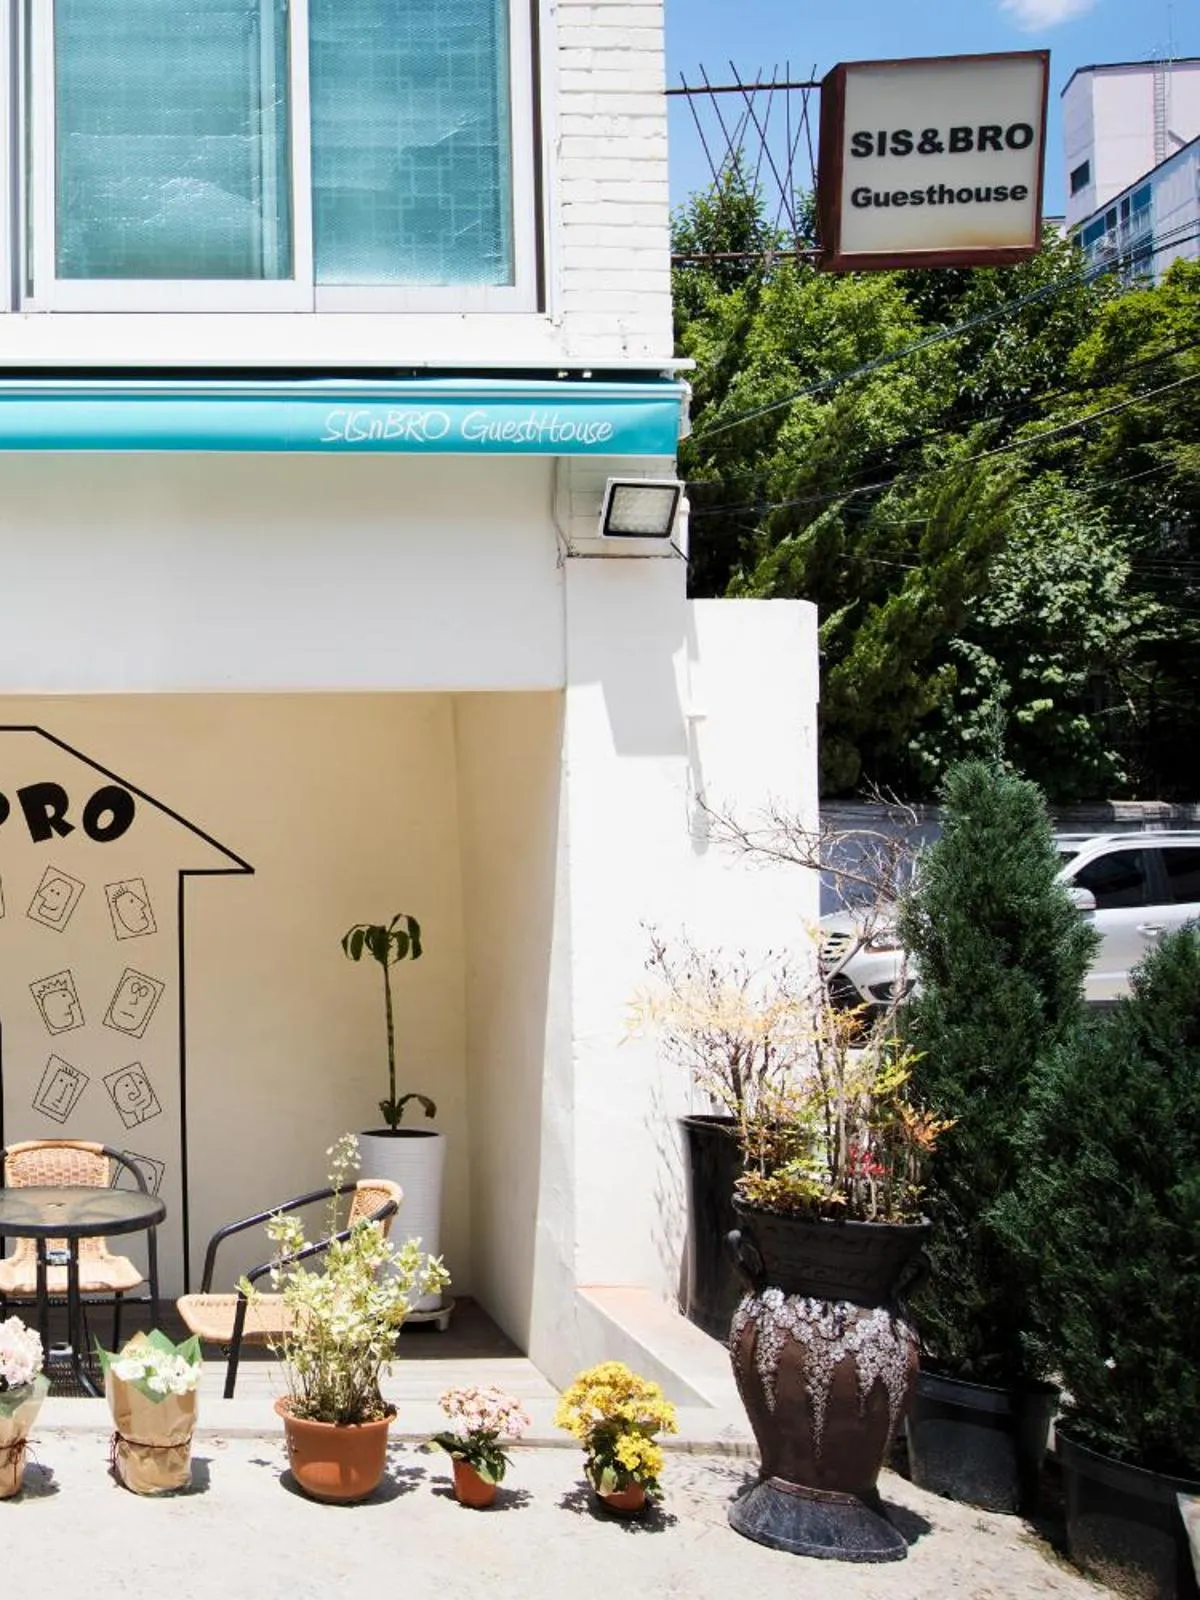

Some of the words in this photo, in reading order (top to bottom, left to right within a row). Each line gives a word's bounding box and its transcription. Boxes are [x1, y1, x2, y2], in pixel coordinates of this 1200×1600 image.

[850, 123, 1034, 158] SIS&BRO
[851, 184, 1029, 208] Guesthouse
[461, 410, 614, 444] GuestHouse
